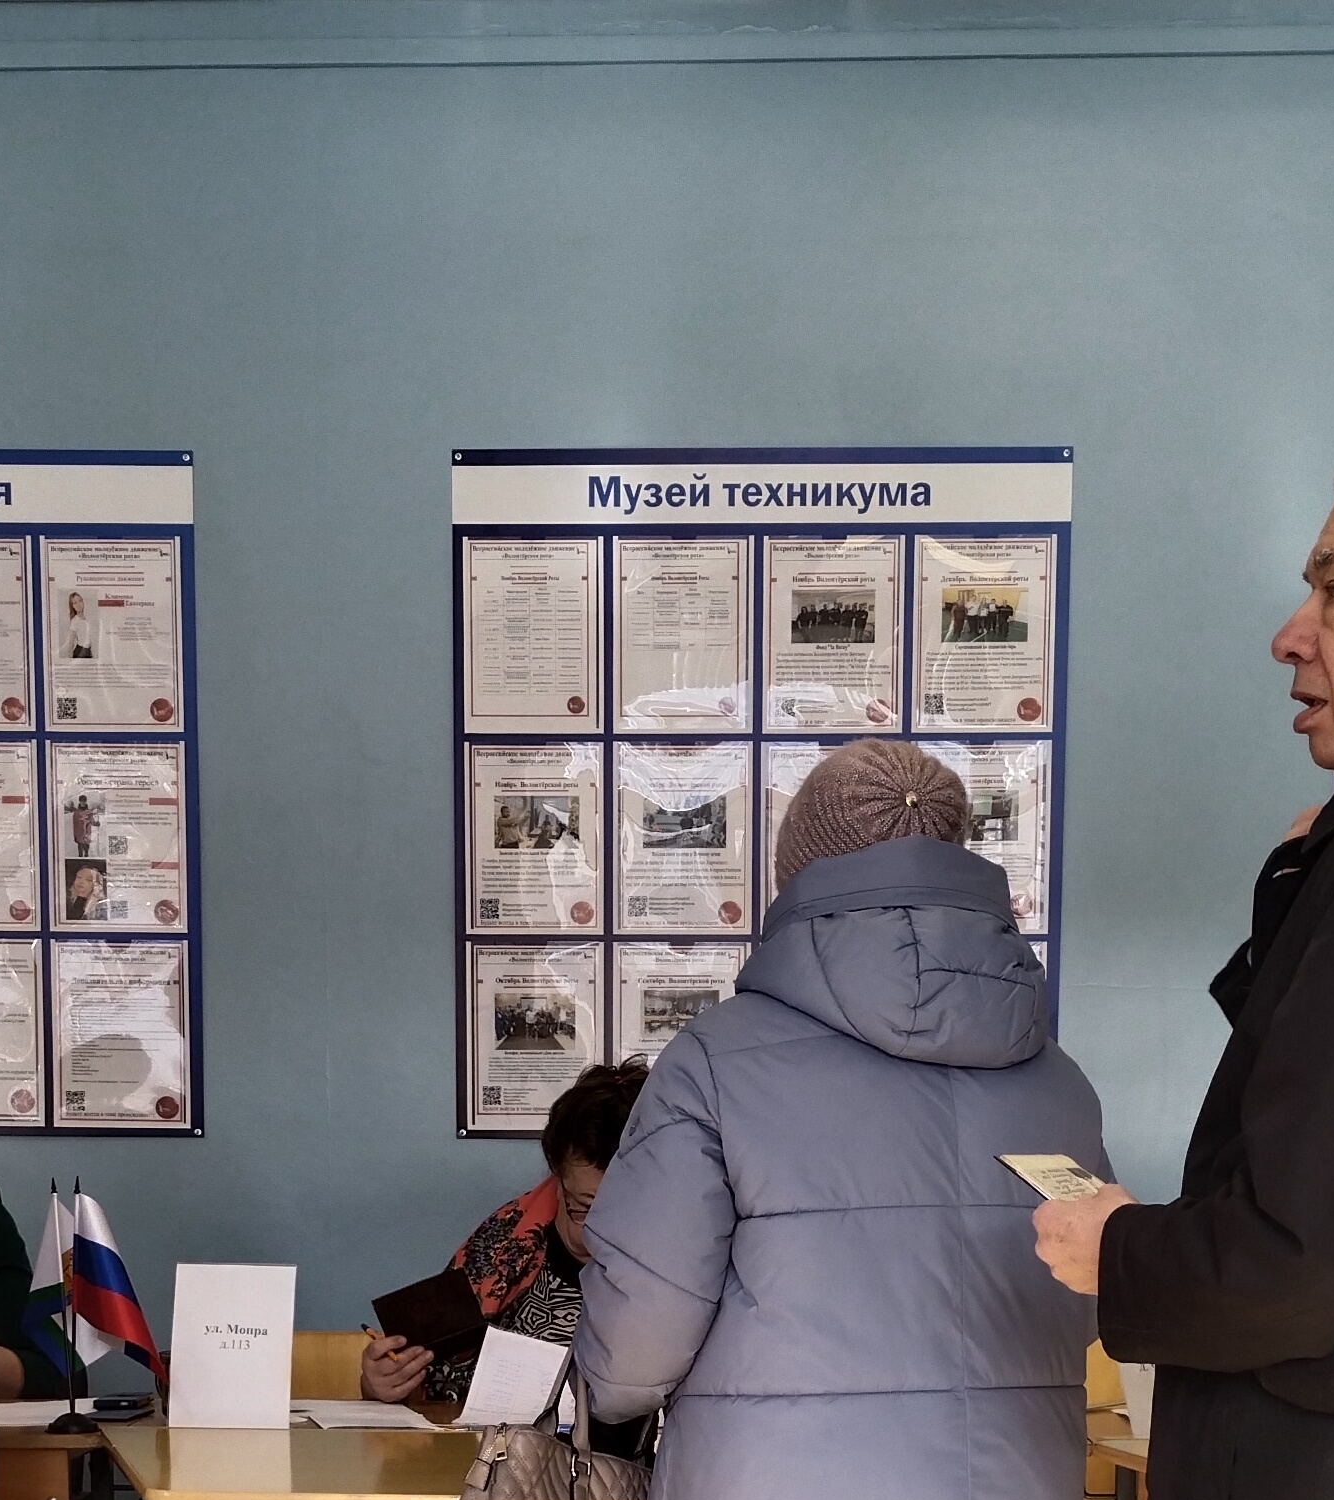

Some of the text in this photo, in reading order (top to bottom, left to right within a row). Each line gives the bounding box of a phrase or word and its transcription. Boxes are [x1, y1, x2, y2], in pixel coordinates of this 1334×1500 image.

[587, 473, 932, 515] Музей техникума
[204, 1323, 268, 1338] ул. Мопра
[218, 1339, 251, 1350] д.113
